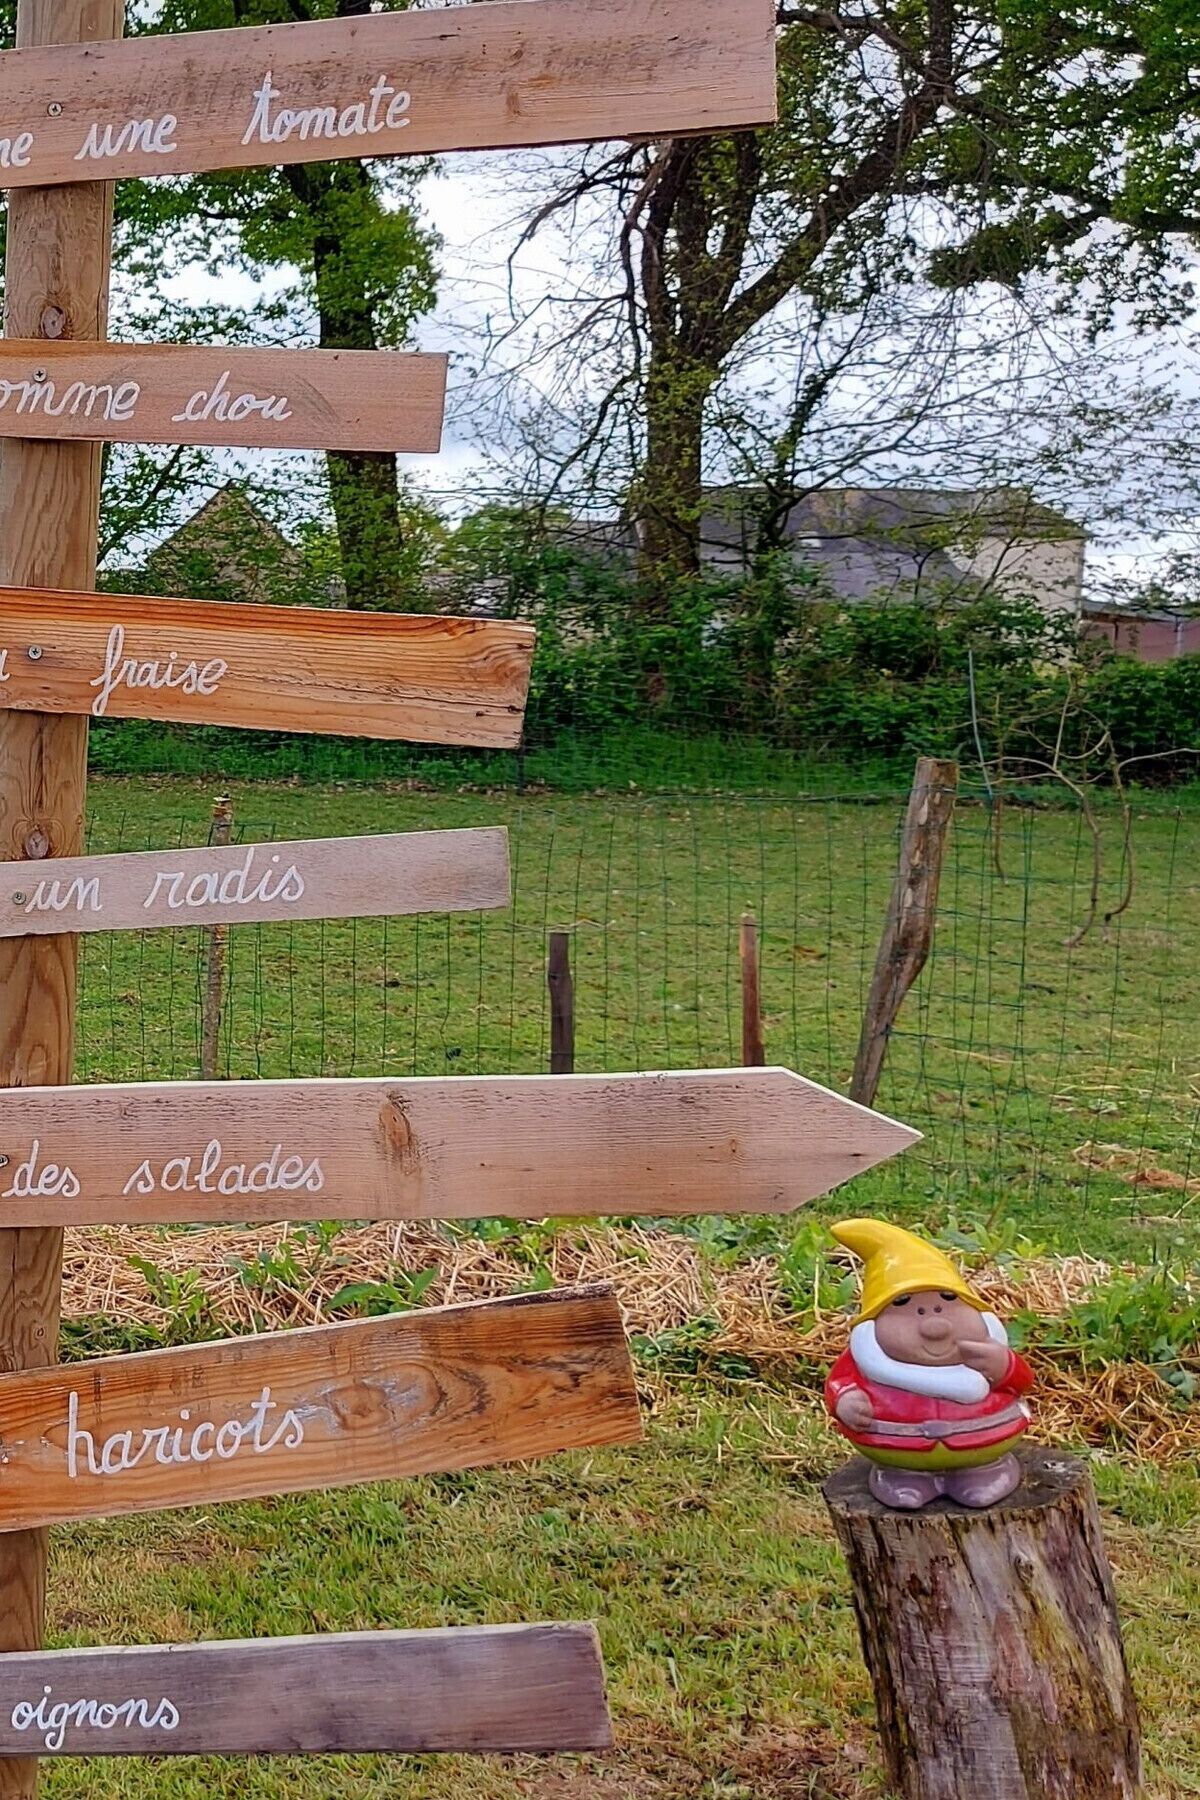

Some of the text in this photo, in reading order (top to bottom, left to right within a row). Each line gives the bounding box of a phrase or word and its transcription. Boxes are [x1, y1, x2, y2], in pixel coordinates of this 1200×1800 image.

[74, 113, 178, 160] une
[241, 70, 411, 145] tomate
[171, 370, 293, 423] chou
[90, 623, 229, 716] fraise
[24, 877, 103, 914] un
[143, 847, 306, 909] radis
[1, 1139, 81, 1198] des
[122, 1138, 326, 1195] salades
[65, 1386, 306, 1478] haricots
[11, 1685, 181, 1749] oignons
